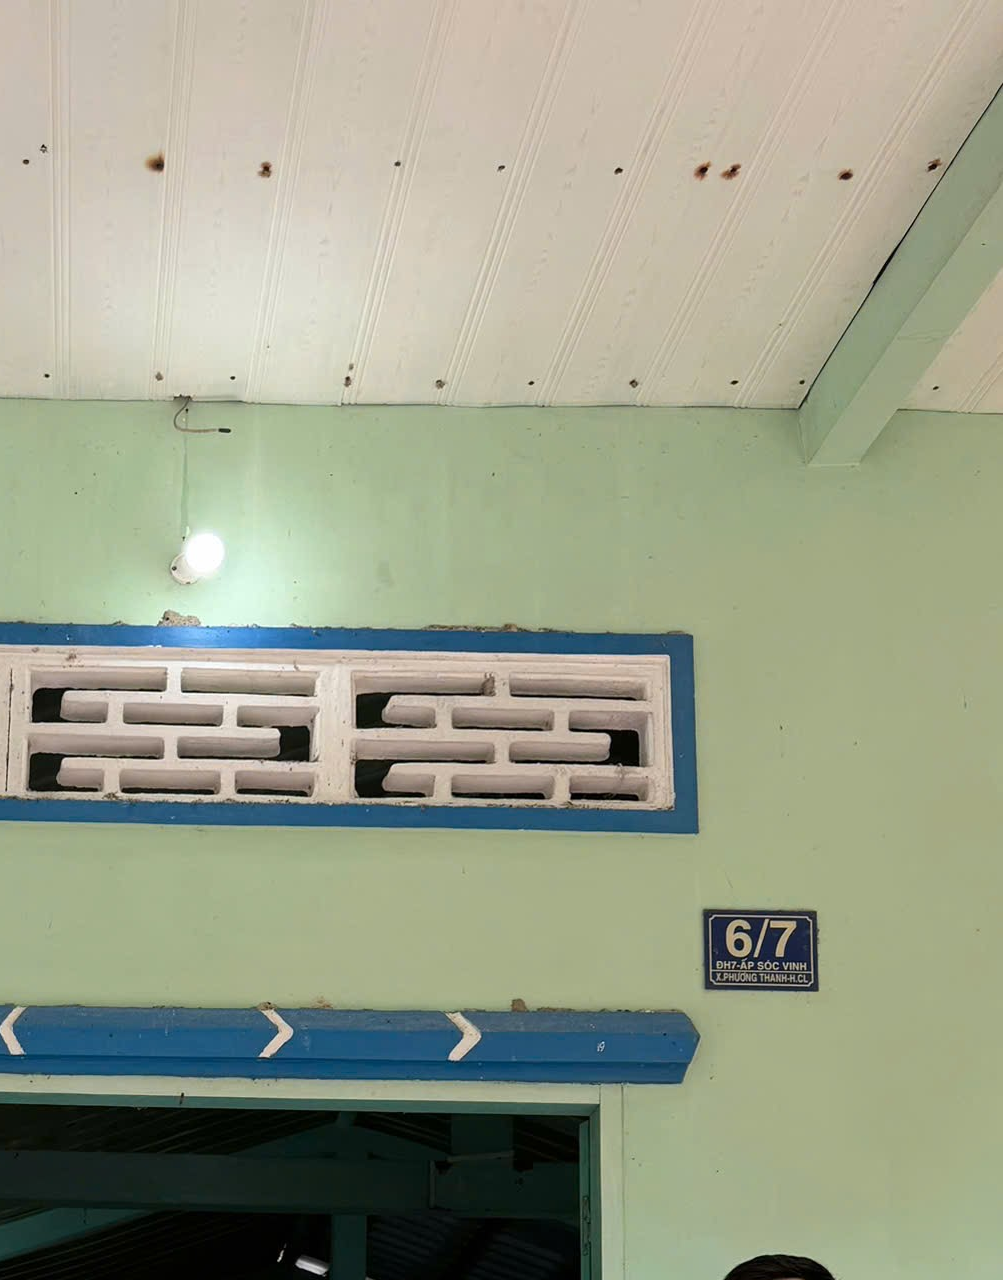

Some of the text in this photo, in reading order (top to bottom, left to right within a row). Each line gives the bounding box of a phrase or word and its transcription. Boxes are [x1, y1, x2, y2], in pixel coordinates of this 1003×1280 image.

[725, 918, 797, 958] 6/7
[757, 959, 780, 971] SÓC
[782, 961, 807, 971] VINH
